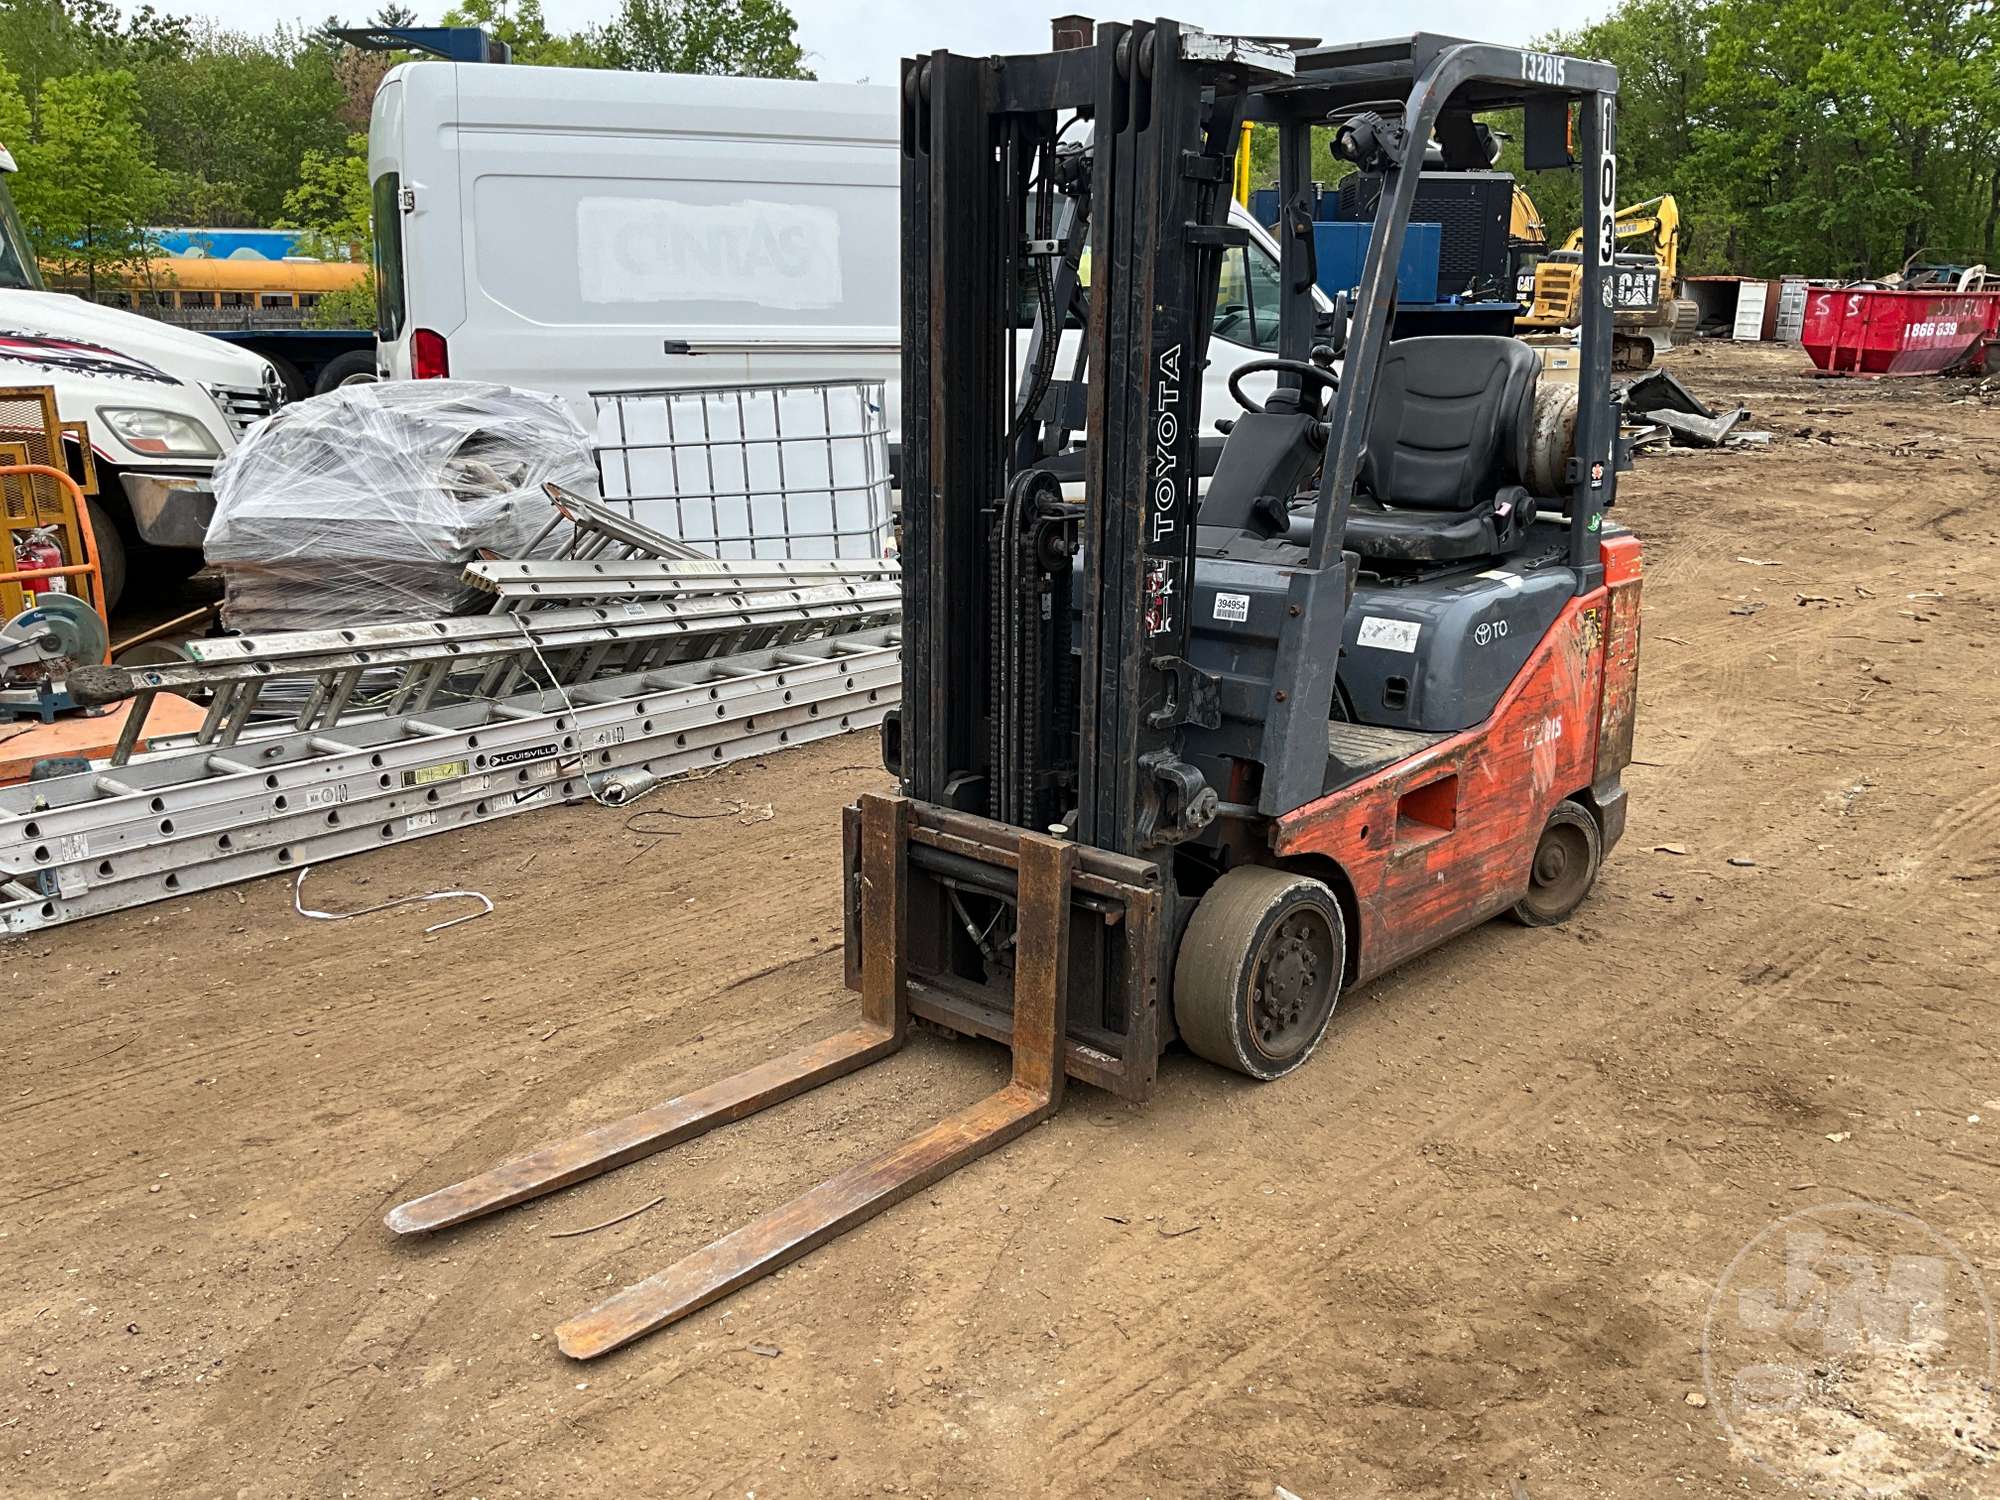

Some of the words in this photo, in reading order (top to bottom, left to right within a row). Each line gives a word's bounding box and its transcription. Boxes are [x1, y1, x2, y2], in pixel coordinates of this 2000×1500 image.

[1521, 53, 1565, 86] T32815
[1516, 276, 1536, 292] CAT
[1618, 273, 1657, 305] CAT
[1153, 343, 1182, 542] TOYOTA
[1217, 598, 1246, 610] 394954
[501, 745, 558, 763] LOUISVILLE
